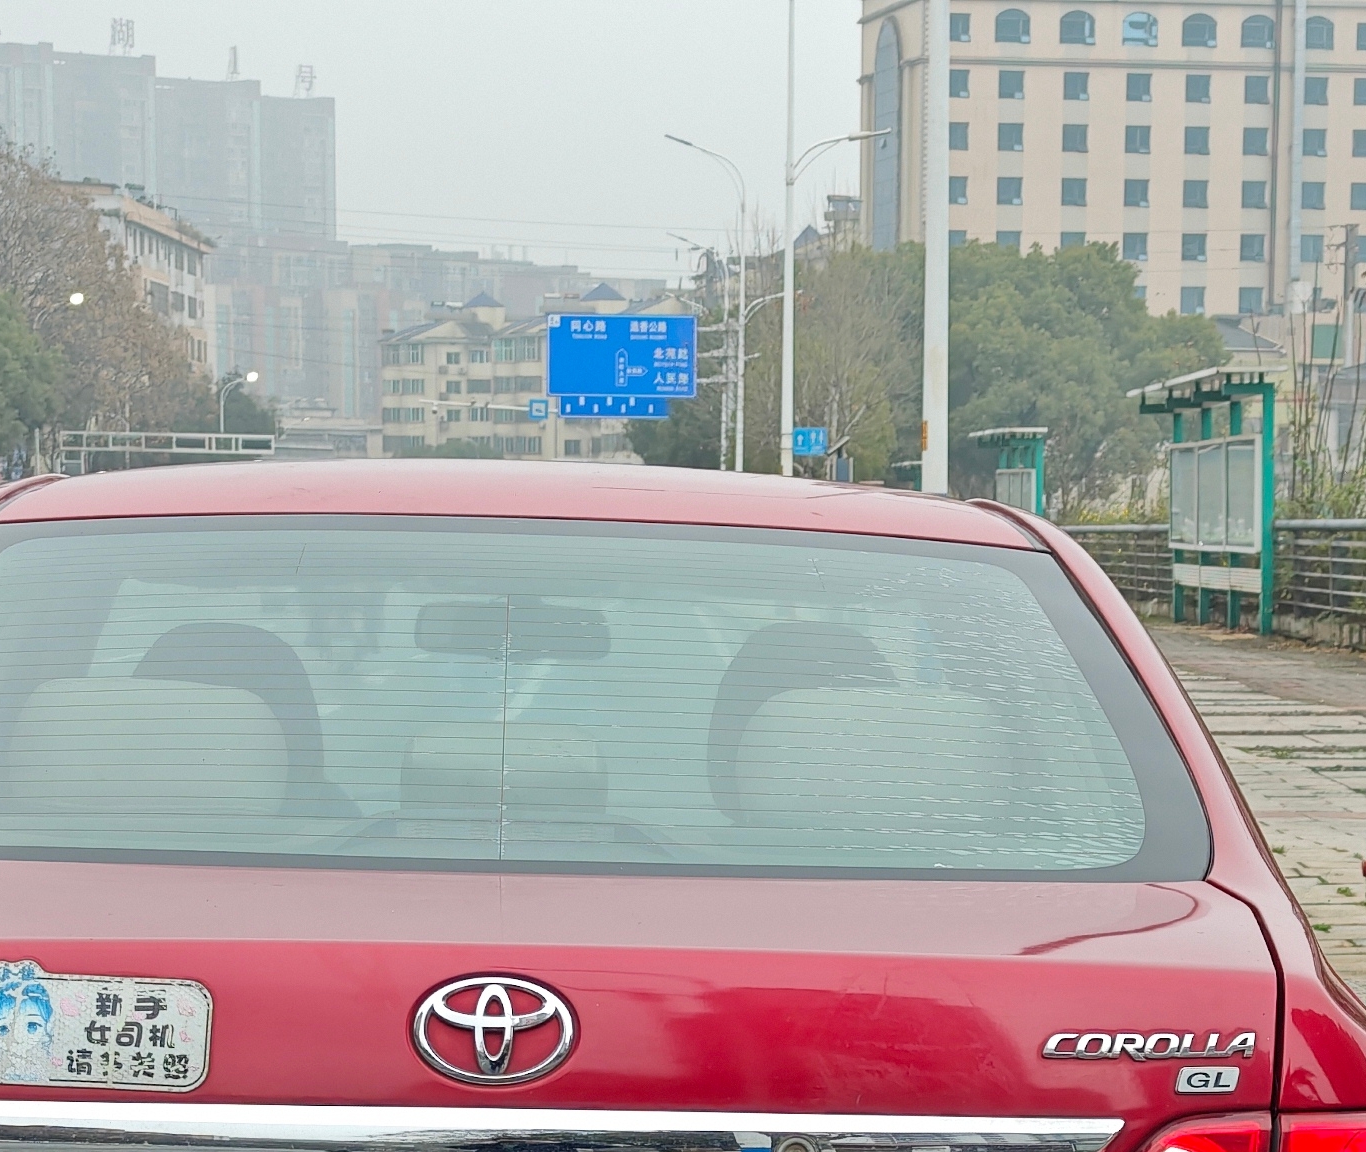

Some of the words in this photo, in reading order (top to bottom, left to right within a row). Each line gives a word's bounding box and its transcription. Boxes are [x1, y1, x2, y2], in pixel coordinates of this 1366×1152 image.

[83, 1020, 177, 1050] 女司机
[1041, 1031, 1257, 1063] COROLLA
[1185, 1071, 1232, 1089] GL
